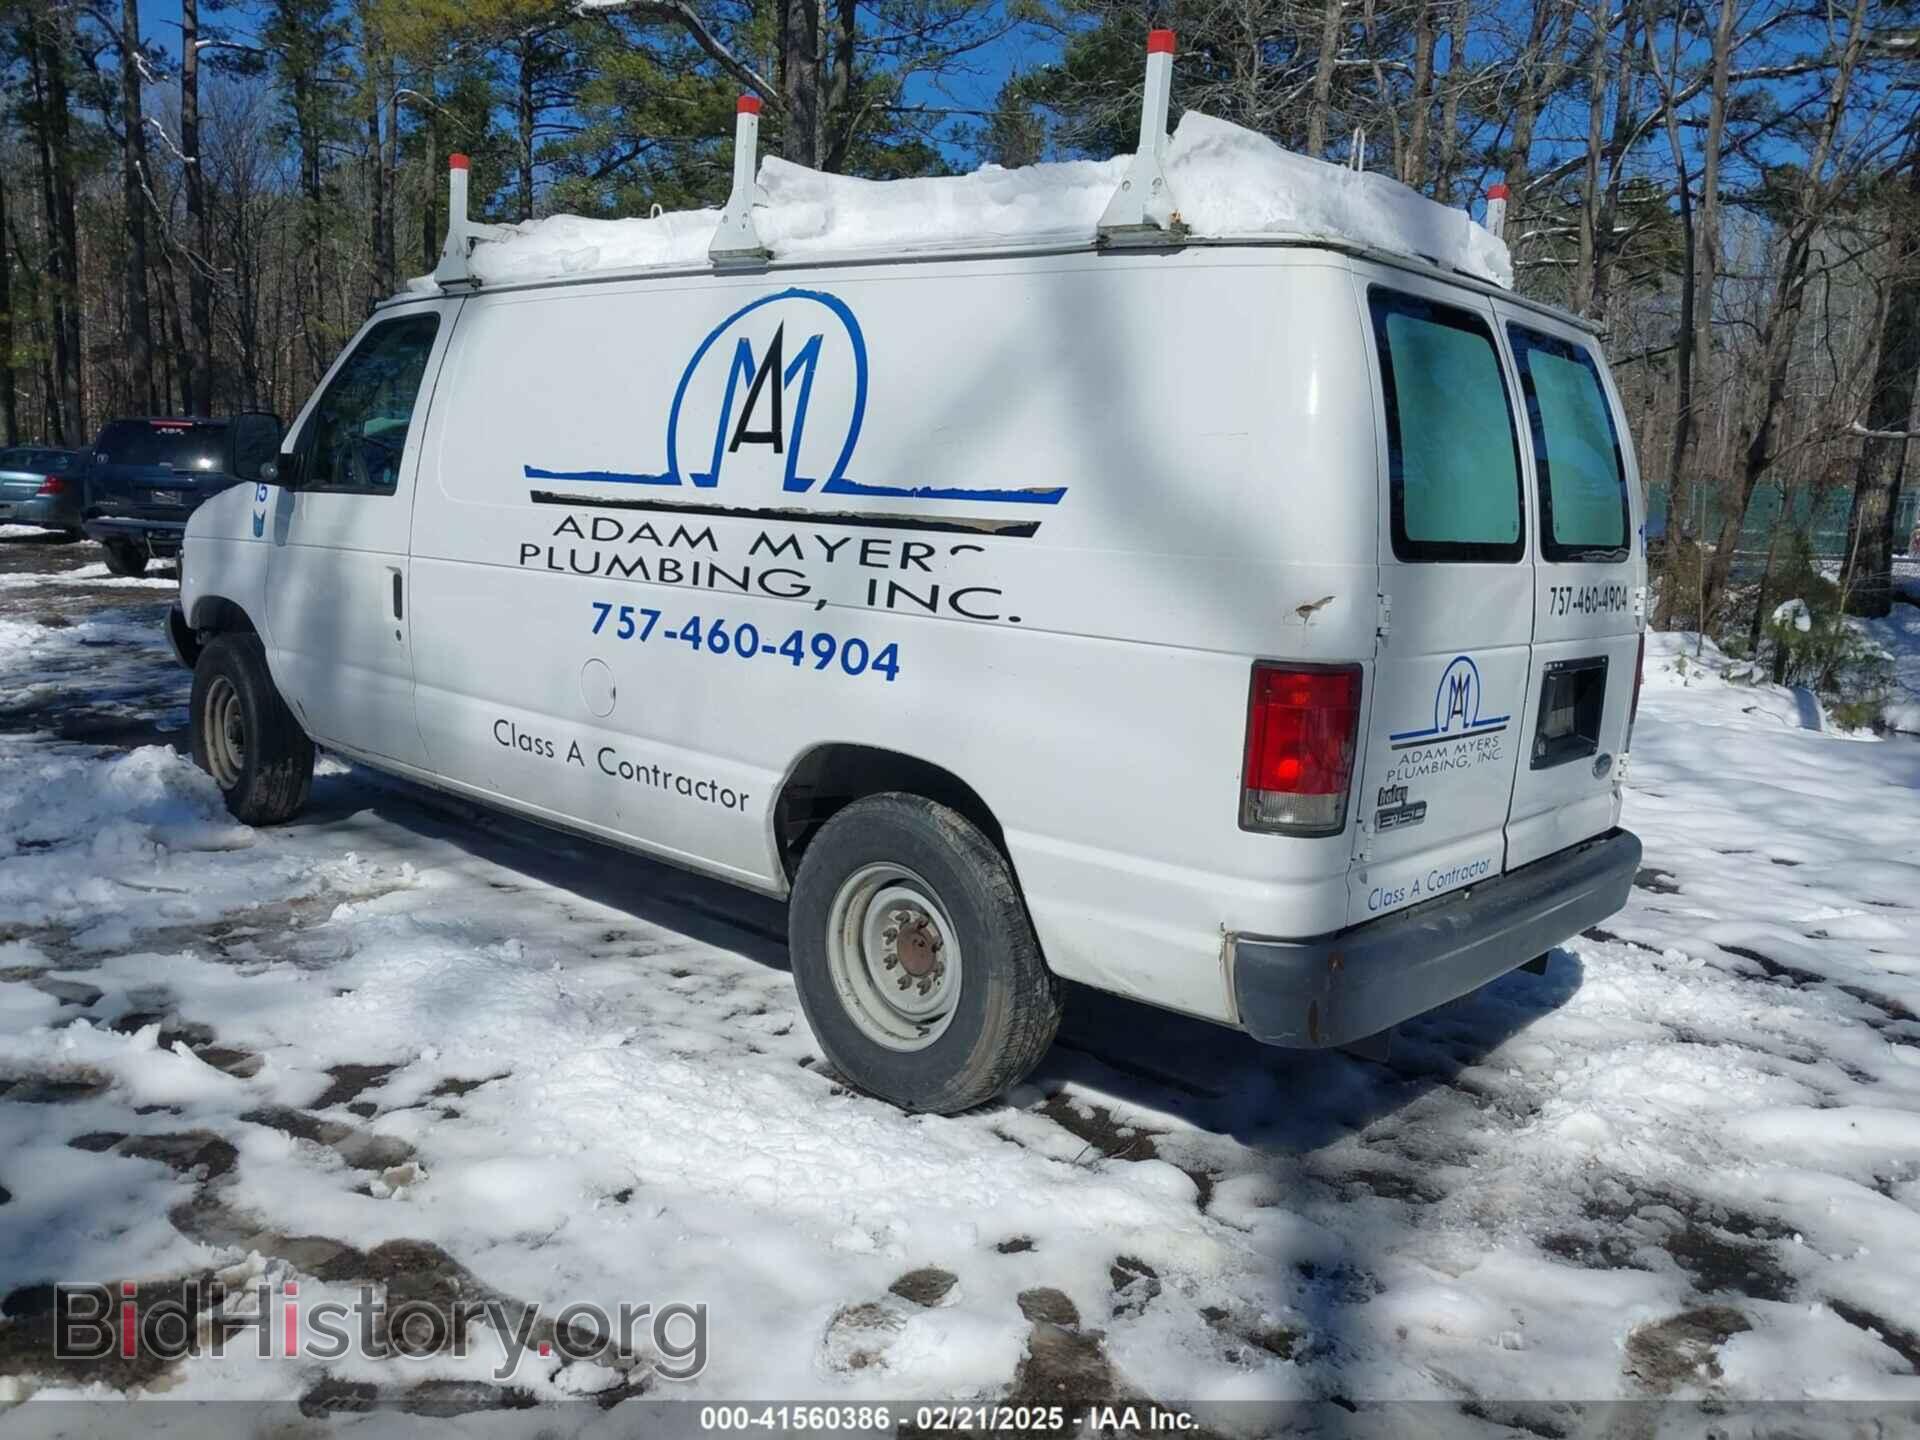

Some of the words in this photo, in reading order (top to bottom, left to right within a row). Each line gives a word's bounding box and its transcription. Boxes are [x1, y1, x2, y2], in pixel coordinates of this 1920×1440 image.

[552, 514, 719, 552] ADAM
[519, 543, 827, 611] PLUMBING,
[867, 578, 1022, 623] INC.
[1550, 584, 1628, 616] 757-460-4904
[591, 601, 900, 682] 757-460-4904
[493, 719, 554, 758] Class
[566, 740, 585, 767] A
[597, 746, 750, 812] Contractor
[1386, 756, 1472, 782] PLUMBING,
[1399, 747, 1448, 766] ADAM
[1454, 735, 1500, 755] MYERS
[1367, 887, 1405, 911] Class
[1411, 879, 1421, 897] A
[1427, 857, 1491, 892] Contractor
